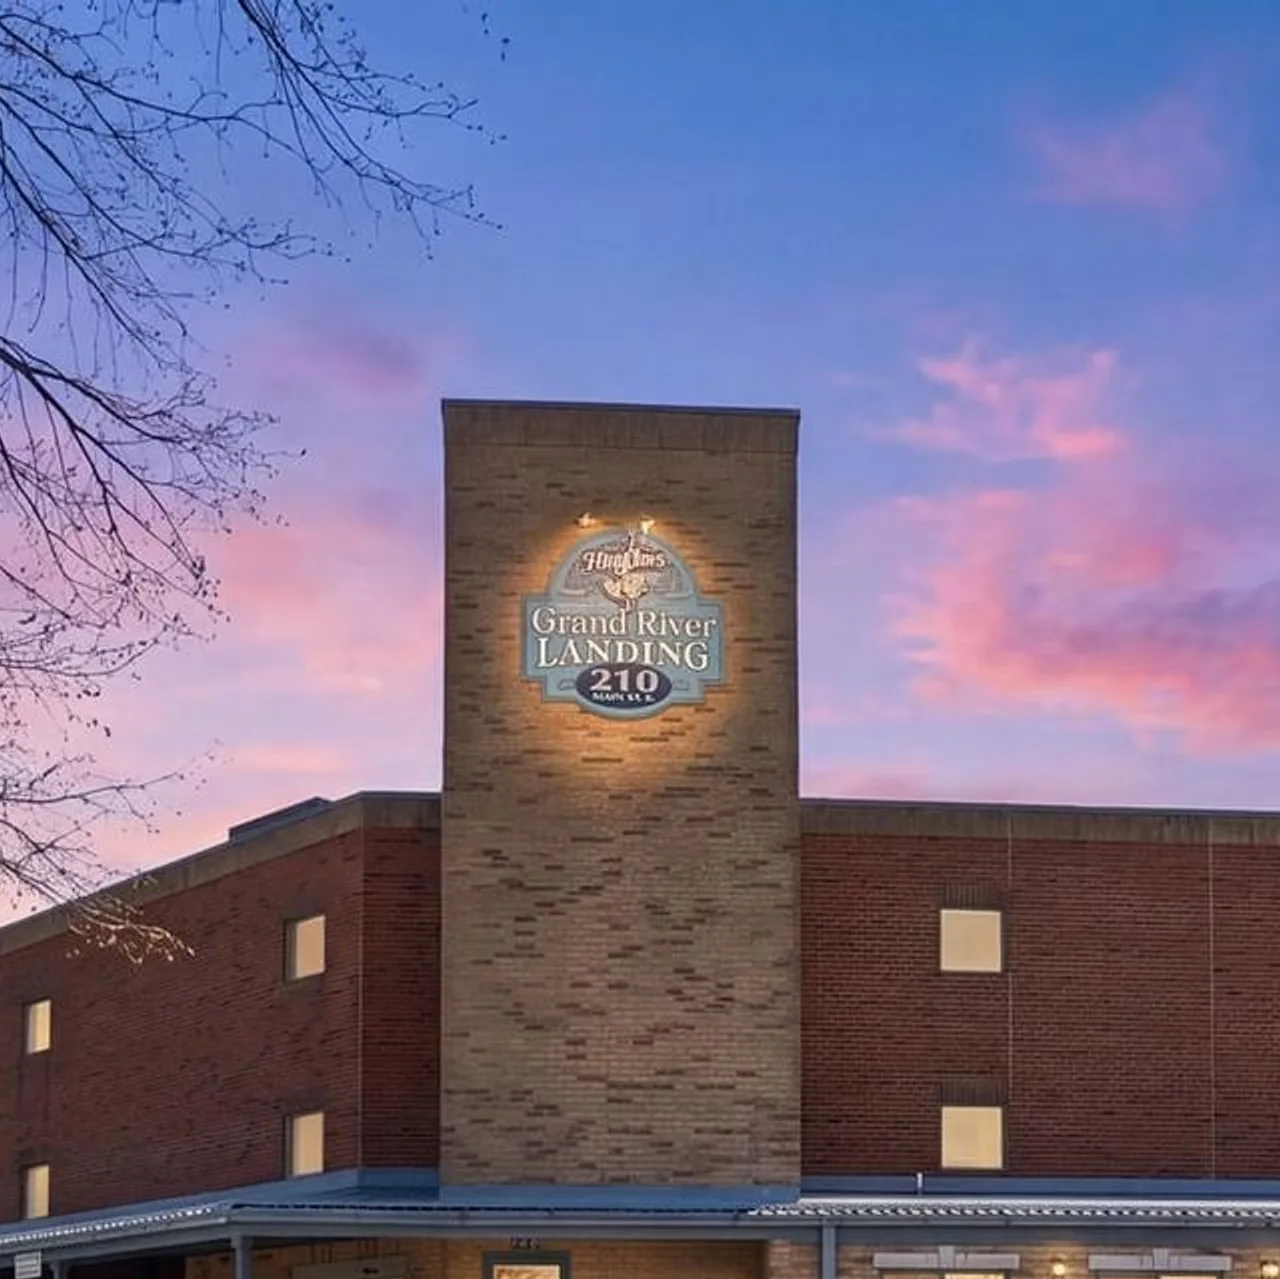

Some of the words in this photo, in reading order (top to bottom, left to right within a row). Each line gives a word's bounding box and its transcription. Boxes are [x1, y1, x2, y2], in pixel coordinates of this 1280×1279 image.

[532, 607, 626, 636] Grand
[638, 610, 717, 637] River
[537, 637, 709, 672] LANDING
[590, 668, 659, 693] 210
